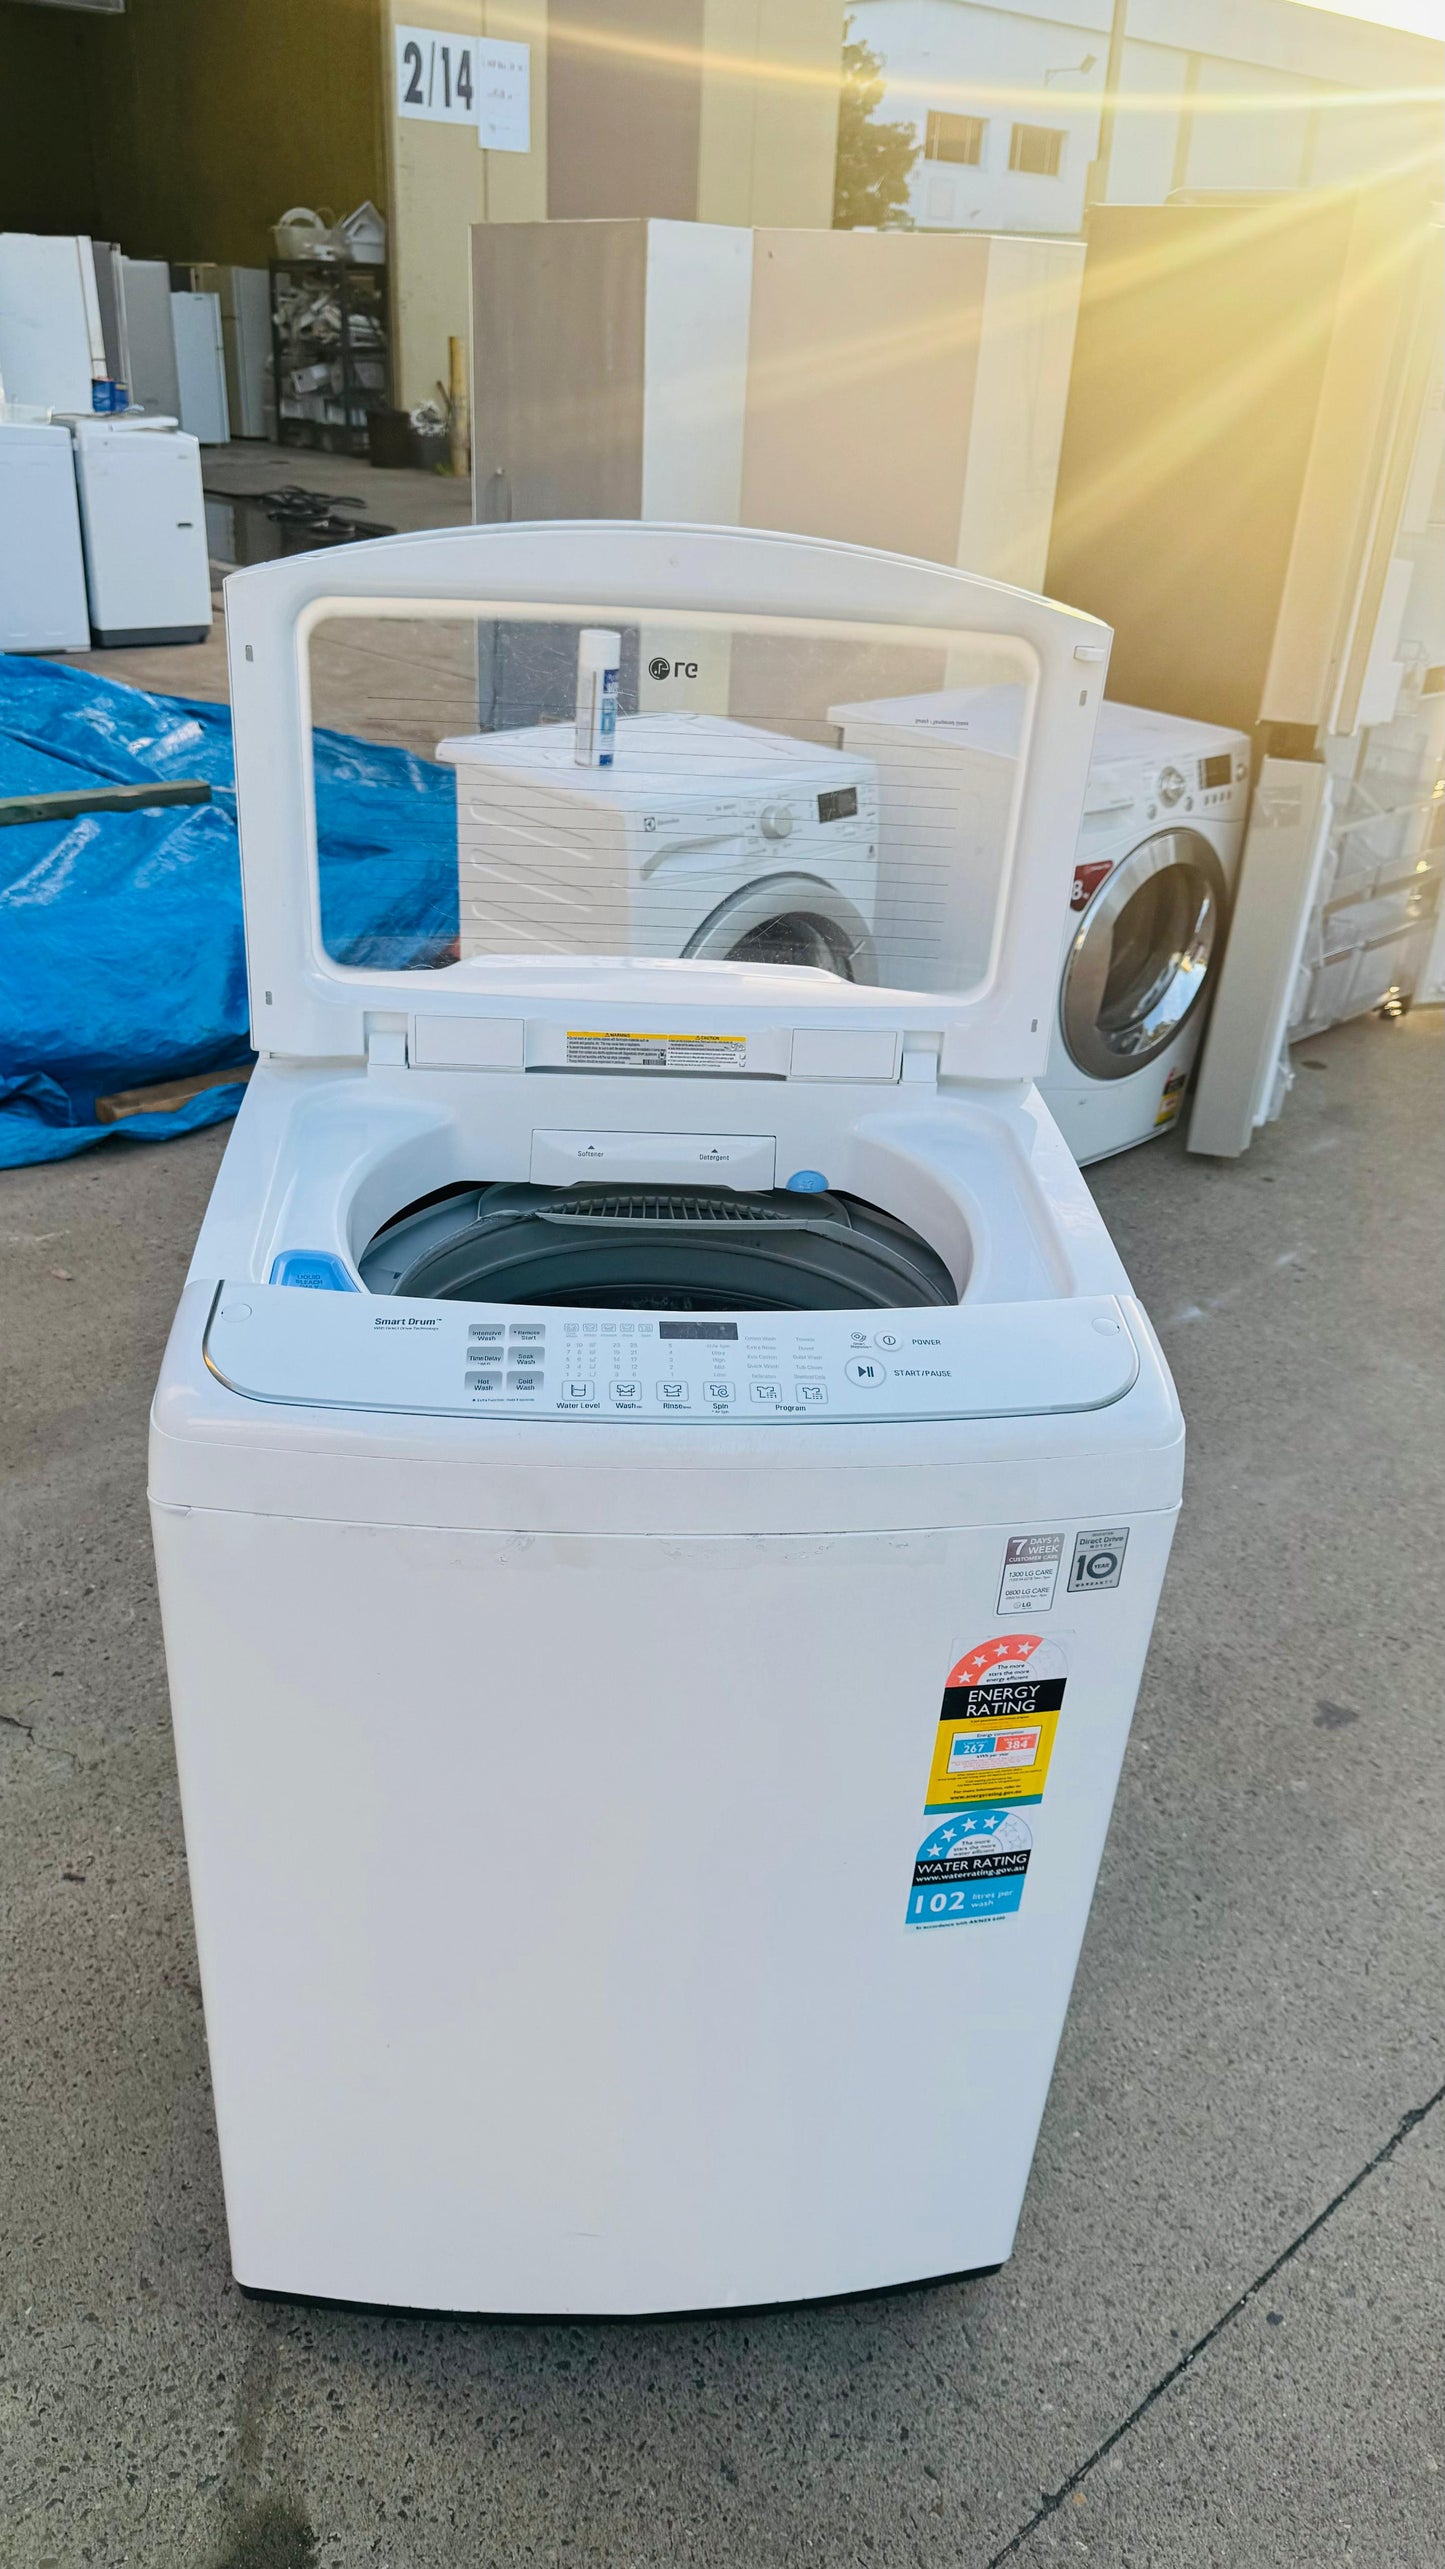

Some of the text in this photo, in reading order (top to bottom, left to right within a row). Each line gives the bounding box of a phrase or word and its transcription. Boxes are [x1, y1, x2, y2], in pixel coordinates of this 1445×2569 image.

[403, 40, 473, 111] 2/14
[699, 1154, 730, 1162] Detergent
[894, 1369, 952, 1377] START/PAUSE
[712, 1402, 729, 1410] Spin
[775, 1404, 807, 1412] Program
[1030, 1537, 1052, 1545] DAYS
[1079, 1537, 1102, 1545] Direct
[1012, 1539, 1028, 1555] 7
[1028, 1545, 1060, 1554] WEEK
[1009, 1555, 1042, 1563] CUSTOMER
[1076, 1552, 1118, 1581] 10
[968, 1685, 1041, 1703] ENERGY
[966, 1700, 1036, 1717] RATING
[963, 1744, 985, 1754] 267
[1005, 1740, 1028, 1750] 384
[950, 1790, 1022, 1800] www.energyrating.gov.au
[917, 1853, 1028, 1875] WATER RATING
[915, 1865, 1025, 1882] www.waterrating.gov.au
[972, 1890, 1014, 1900] litres per
[915, 1891, 965, 1914] 102
[971, 1900, 994, 1909] wash
